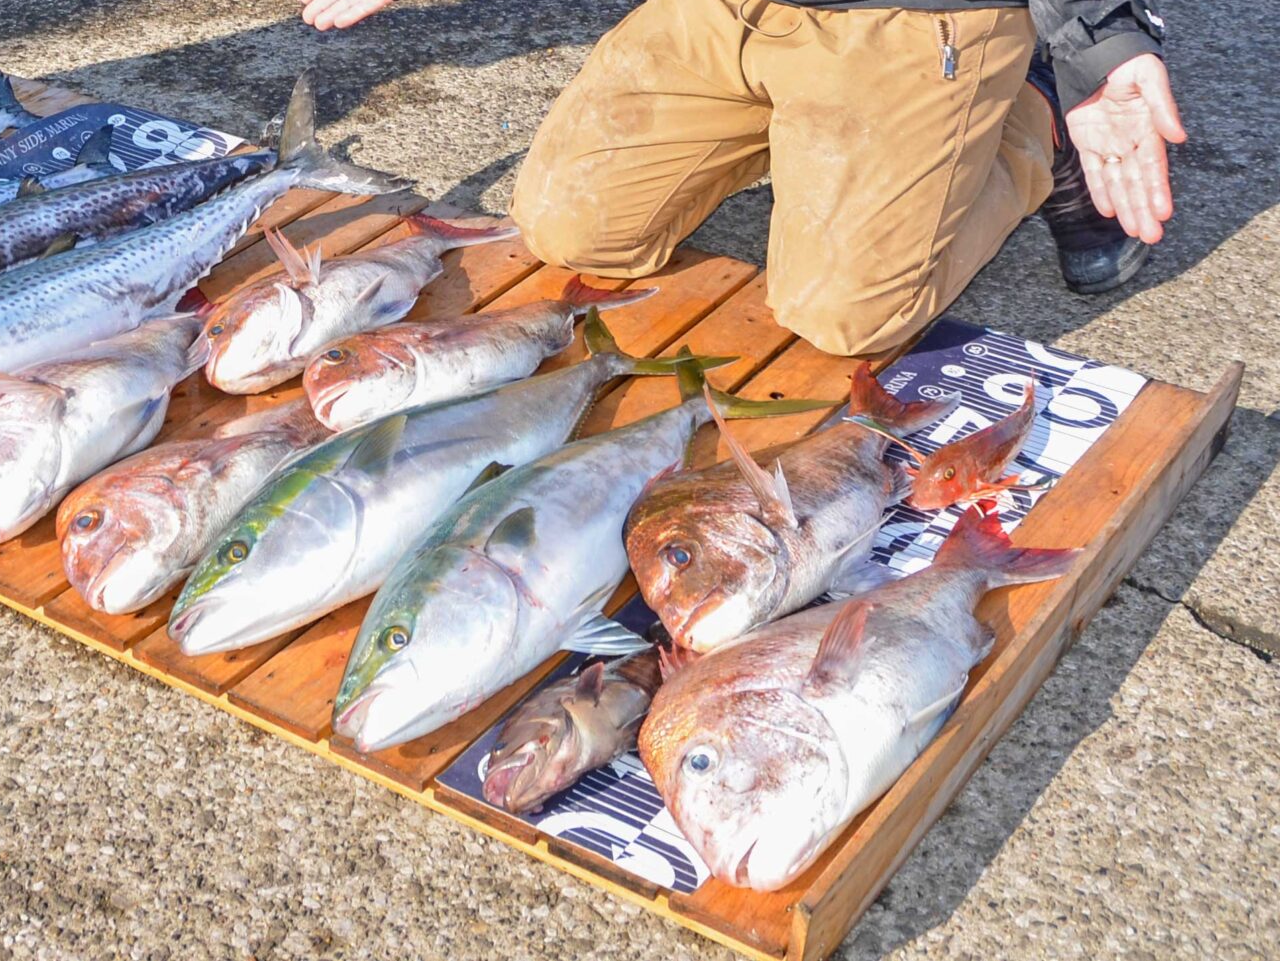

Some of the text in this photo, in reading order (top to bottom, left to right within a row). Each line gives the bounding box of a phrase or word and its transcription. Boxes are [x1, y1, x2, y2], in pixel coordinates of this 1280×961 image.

[19, 129, 47, 154] SIDE
[44, 113, 89, 139] MARINA
[883, 371, 918, 396] RINA
